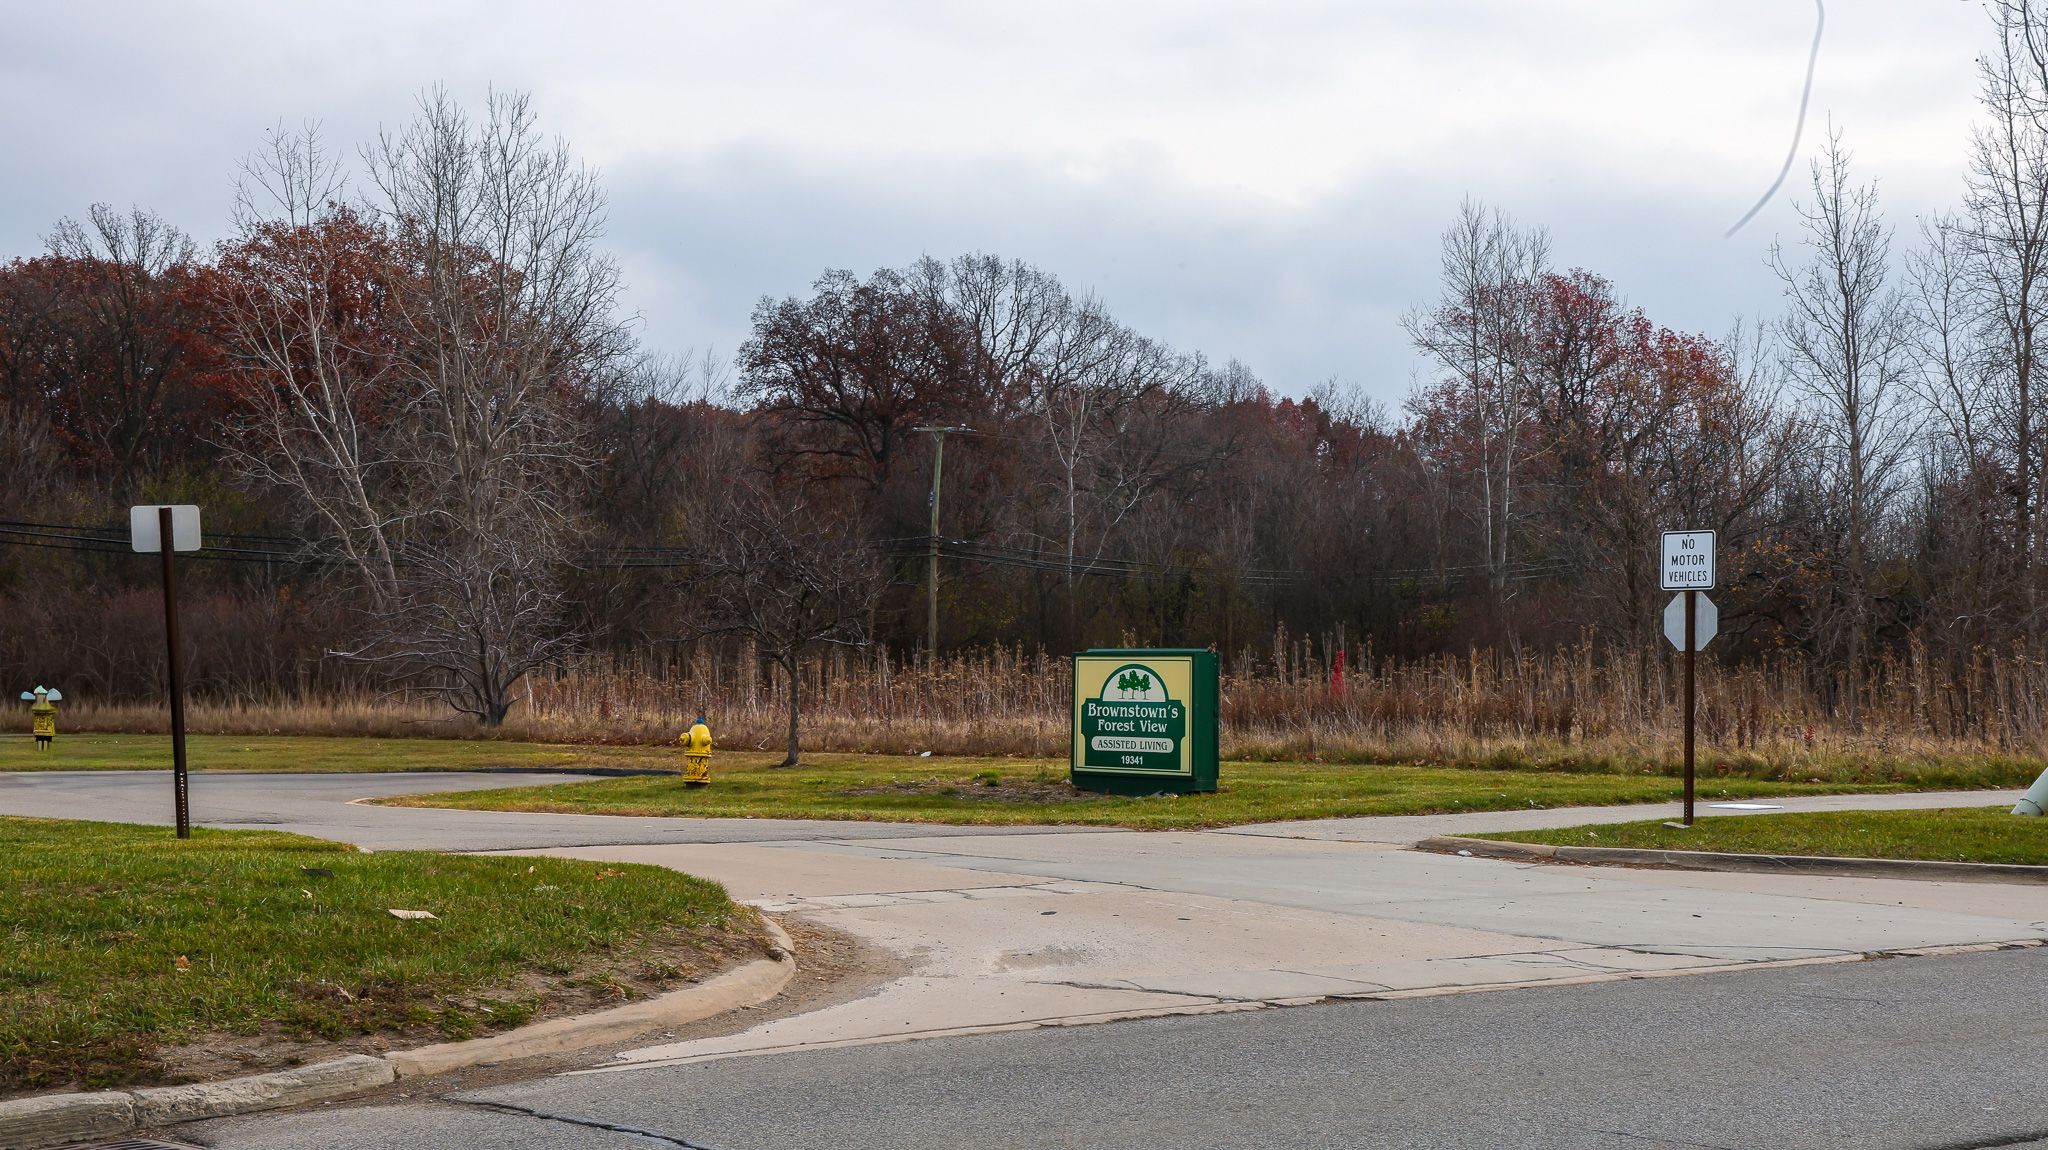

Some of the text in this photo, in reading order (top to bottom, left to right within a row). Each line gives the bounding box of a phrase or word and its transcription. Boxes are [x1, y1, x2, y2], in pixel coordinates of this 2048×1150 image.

[1682, 539, 1695, 550] NO
[1671, 555, 1705, 566] MOTOR
[1669, 571, 1707, 582] VEHICLES
[1088, 703, 1179, 718] Brownstown's
[1097, 719, 1168, 732] Forest View
[1097, 740, 1168, 751] ASSISTED LIVING
[1121, 755, 1143, 765] 19341
